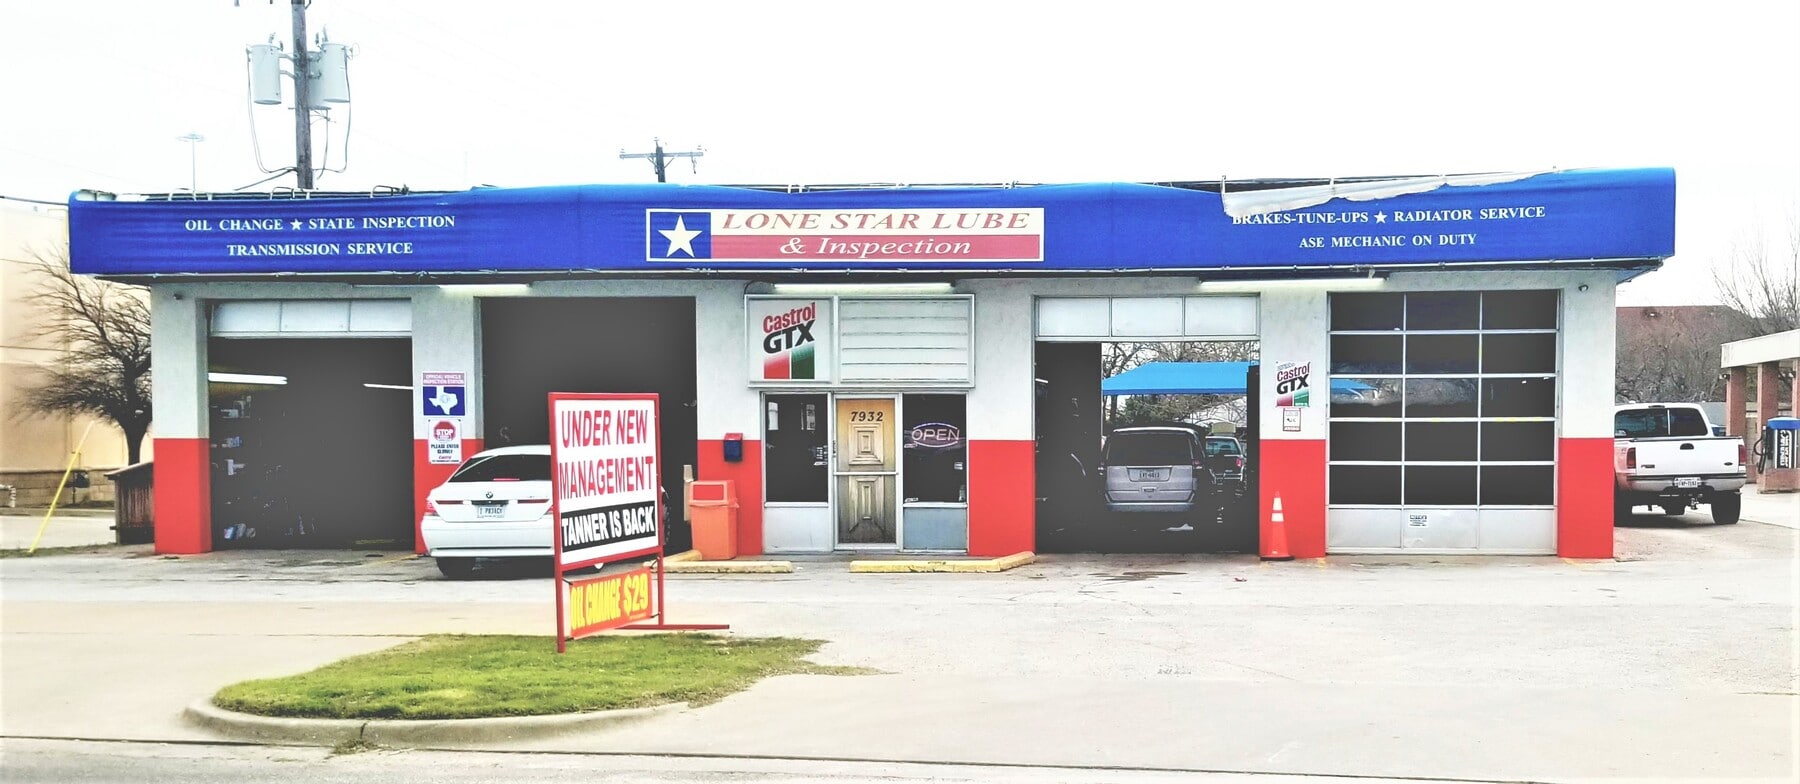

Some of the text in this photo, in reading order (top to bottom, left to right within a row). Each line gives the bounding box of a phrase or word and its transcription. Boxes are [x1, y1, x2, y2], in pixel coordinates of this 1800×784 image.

[184, 215, 455, 231] OIL CHANGE STATE INSPECTION
[721, 212, 1031, 230] LONE STAR LUBE
[1232, 206, 1546, 225] BRAKES-TUNE-UPS RADIATOR SERVICE
[227, 242, 413, 256] TRANSMISSION SERVICE
[779, 237, 972, 258] & Inspection
[1299, 233, 1477, 249] ASE MECHANIC ON DUTY
[763, 302, 816, 333] Castrol
[763, 320, 815, 354] GTX
[1277, 361, 1310, 382] Castrol
[1277, 374, 1309, 395] GTX
[851, 411, 884, 422] 7932
[561, 410, 648, 448] UNDER NEW
[911, 429, 960, 441] OPEN
[559, 456, 653, 500] MANAGEMENT
[562, 506, 655, 546] TANNER IS BACK
[571, 573, 648, 630] OIL CHANGE $29
